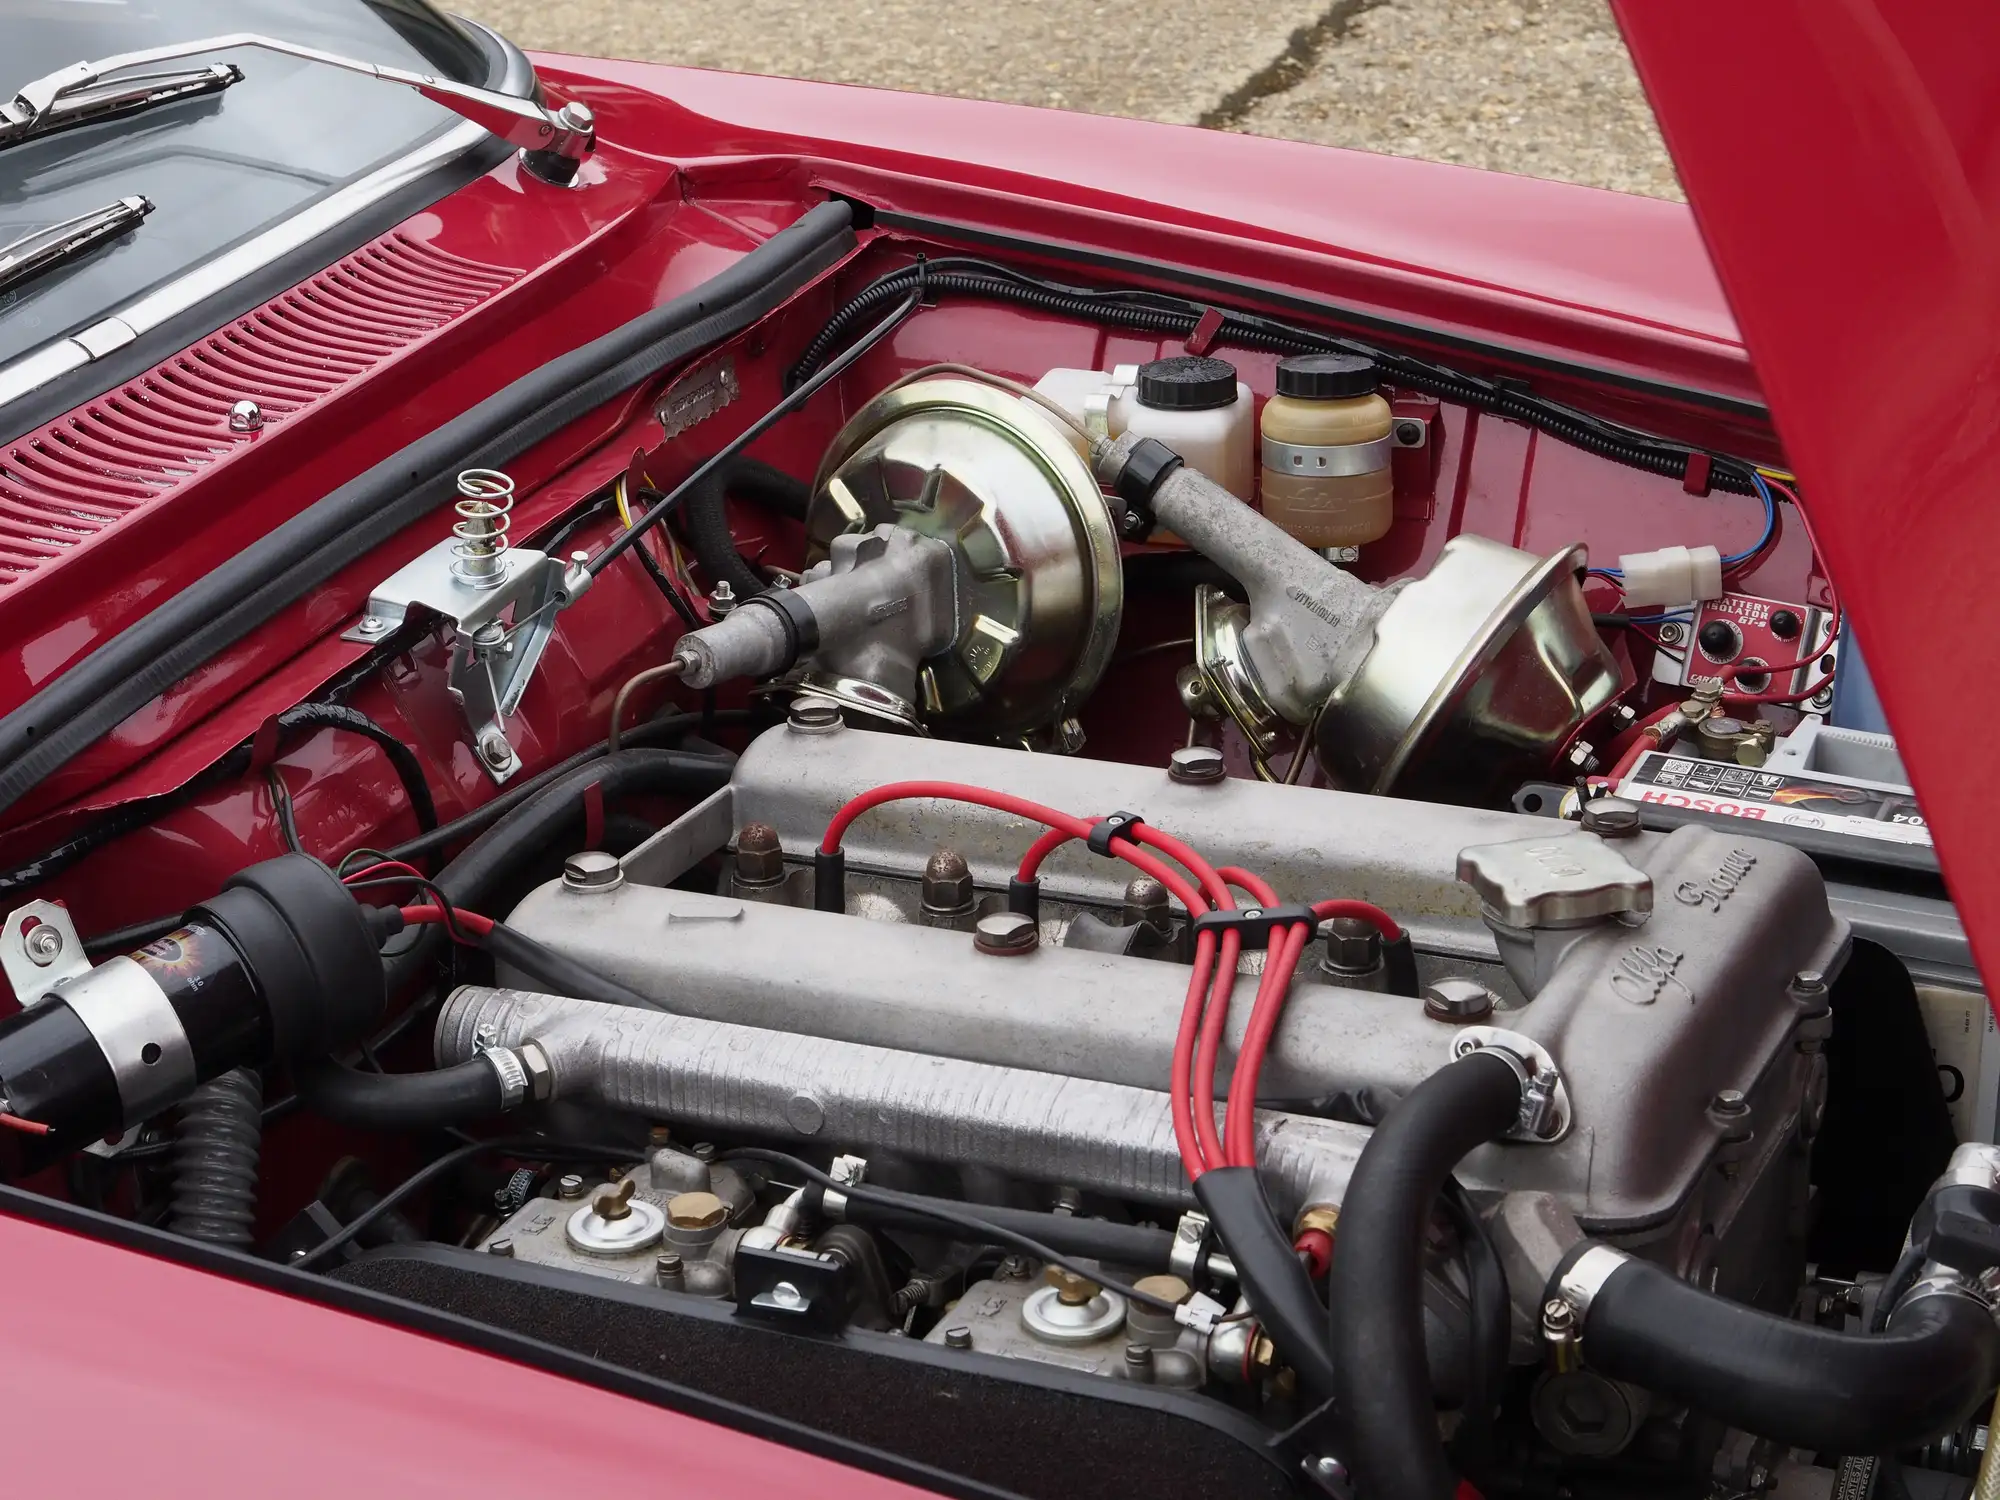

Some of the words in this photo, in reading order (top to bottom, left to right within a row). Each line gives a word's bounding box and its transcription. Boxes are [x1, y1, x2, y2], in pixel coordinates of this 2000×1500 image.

[1706, 603, 1769, 620] ISOLATOR
[1713, 598, 1771, 613] ATTERY
[1643, 791, 1767, 820] BOSCH
[1892, 813, 1928, 827] 04
[1608, 945, 1696, 1005] Alfa
[1673, 848, 1757, 914] Romeo
